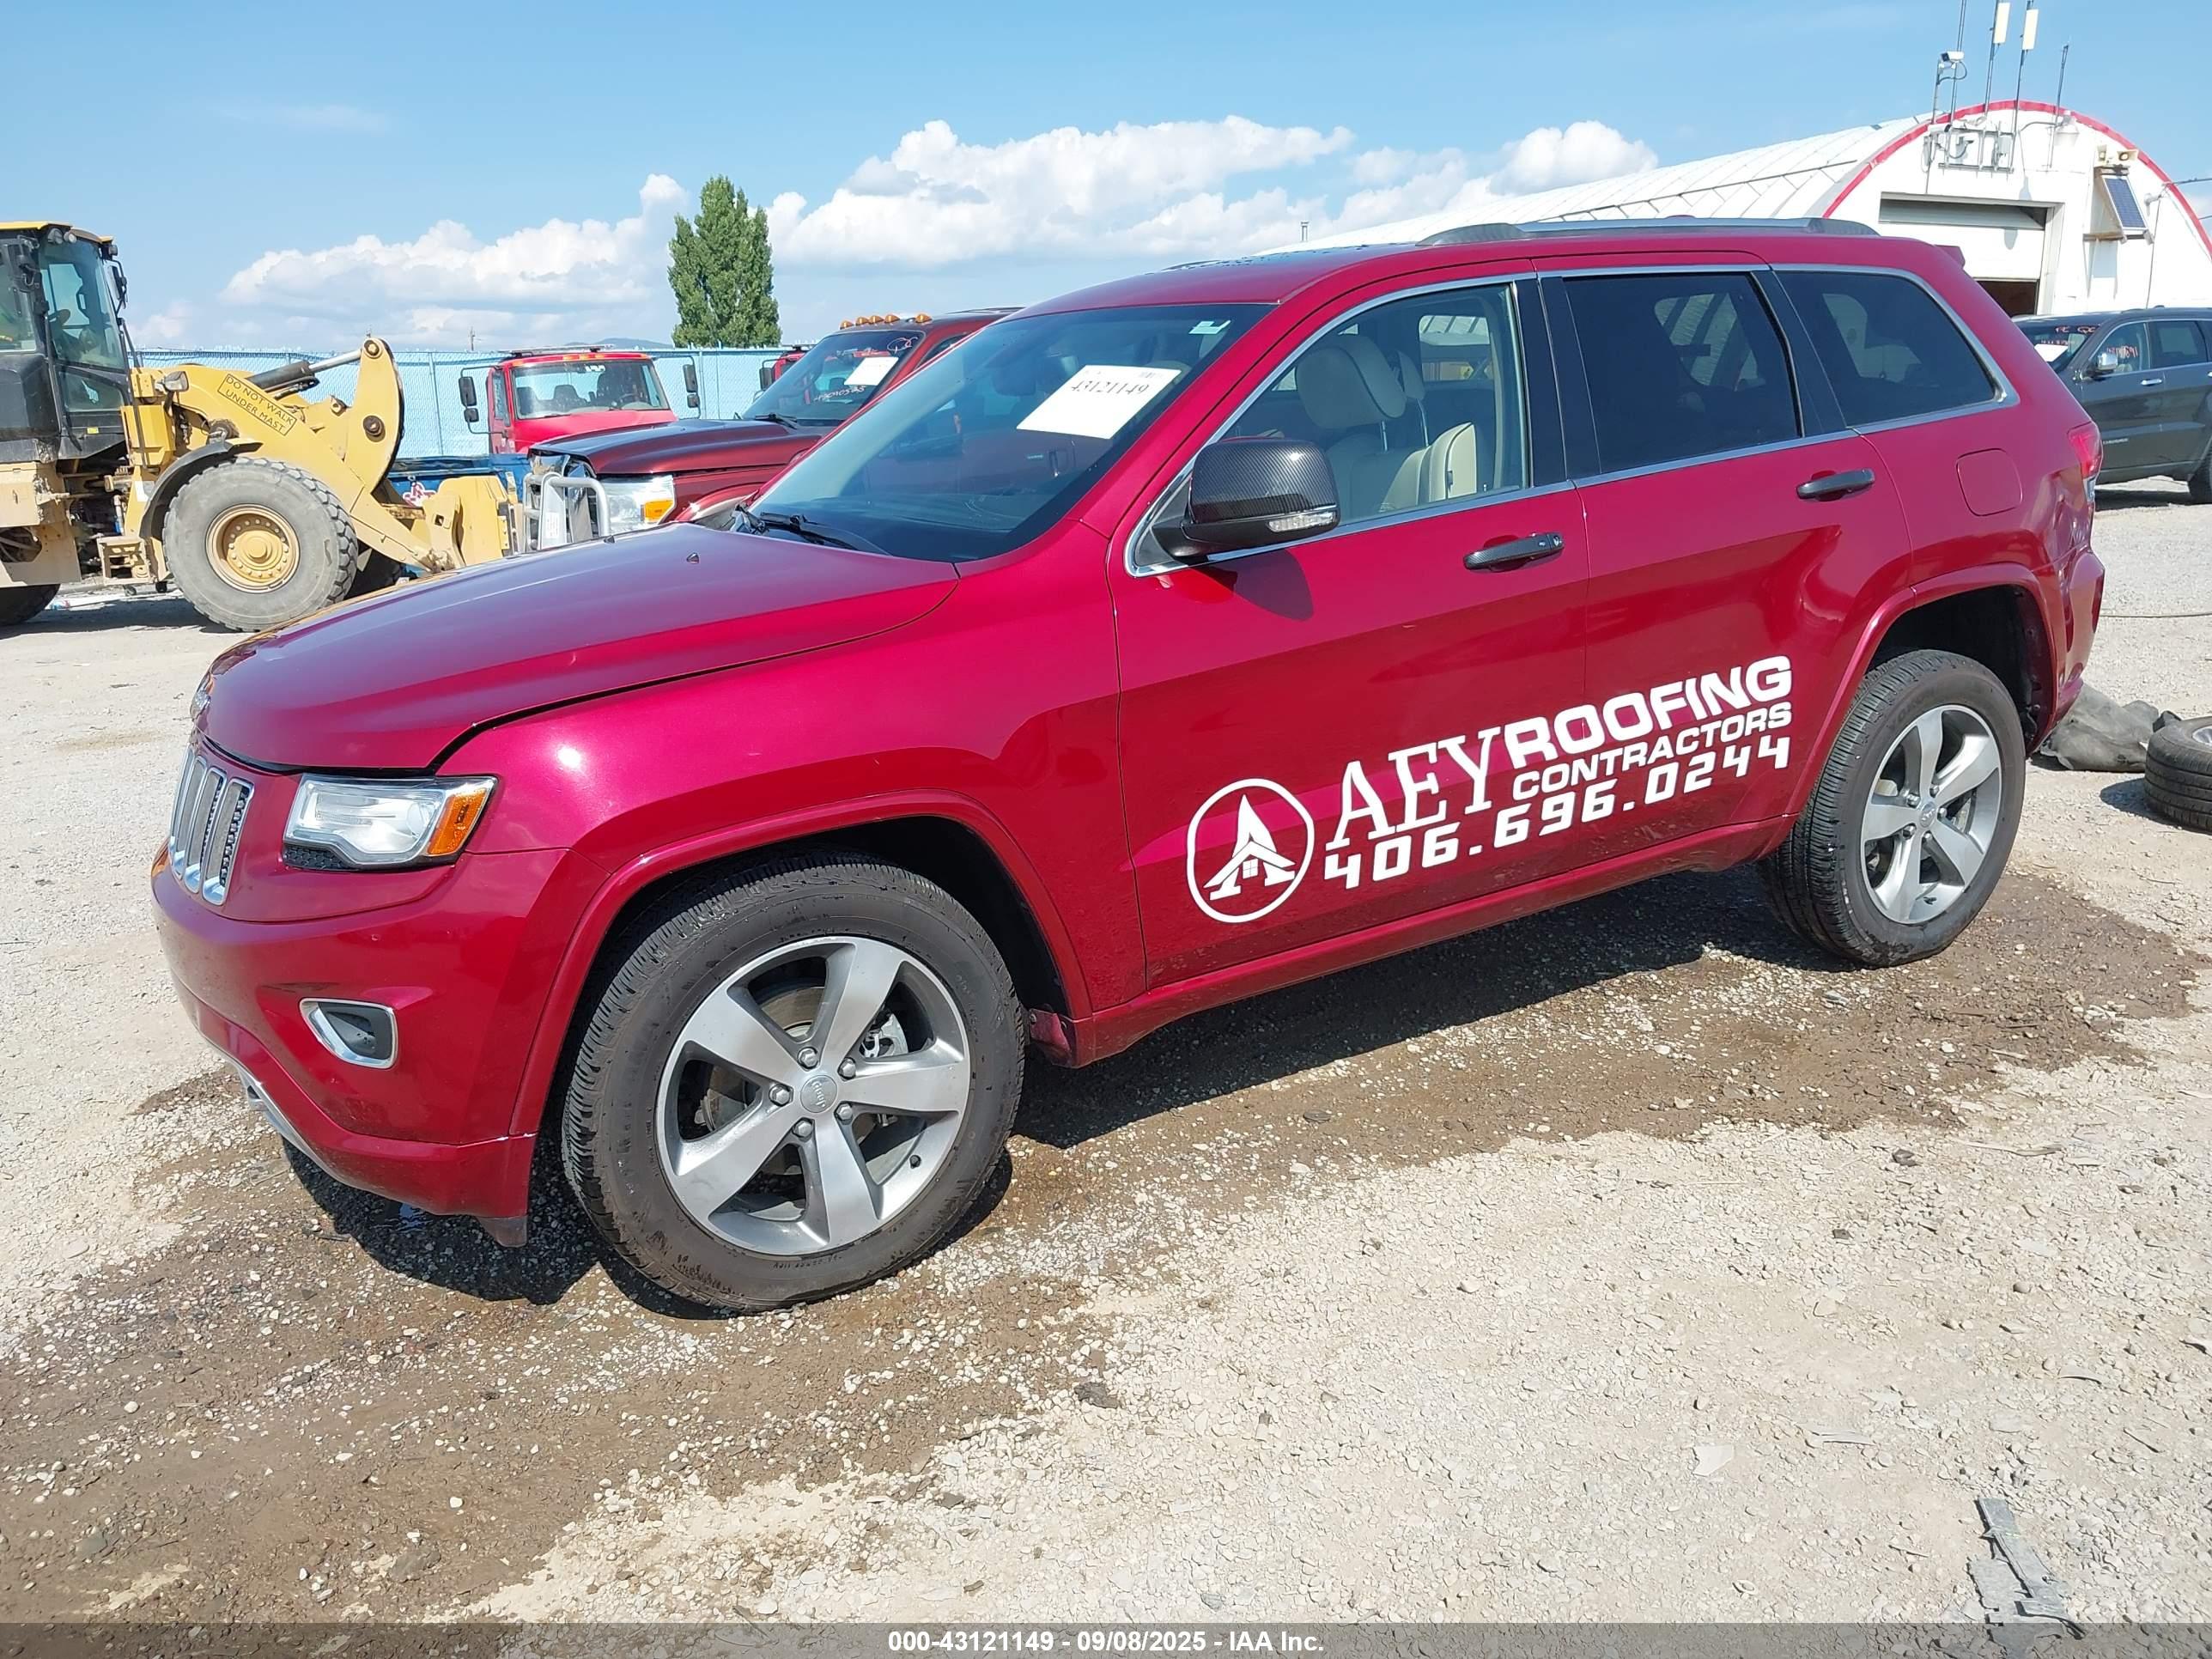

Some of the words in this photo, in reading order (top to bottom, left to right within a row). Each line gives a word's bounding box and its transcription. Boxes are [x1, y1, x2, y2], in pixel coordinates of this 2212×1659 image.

[225, 388, 258, 414] UNDER
[258, 411, 286, 432] MAST
[226, 376, 241, 390] DO
[242, 387, 266, 404] NOT
[266, 403, 293, 425] WALK
[1071, 380, 1150, 396] 43121149
[1325, 726, 1501, 852] AEY
[1504, 655, 1792, 769] ROOFING
[1512, 701, 1792, 801] CONTRACTORS
[1323, 735, 1791, 890] 406.696.0244
